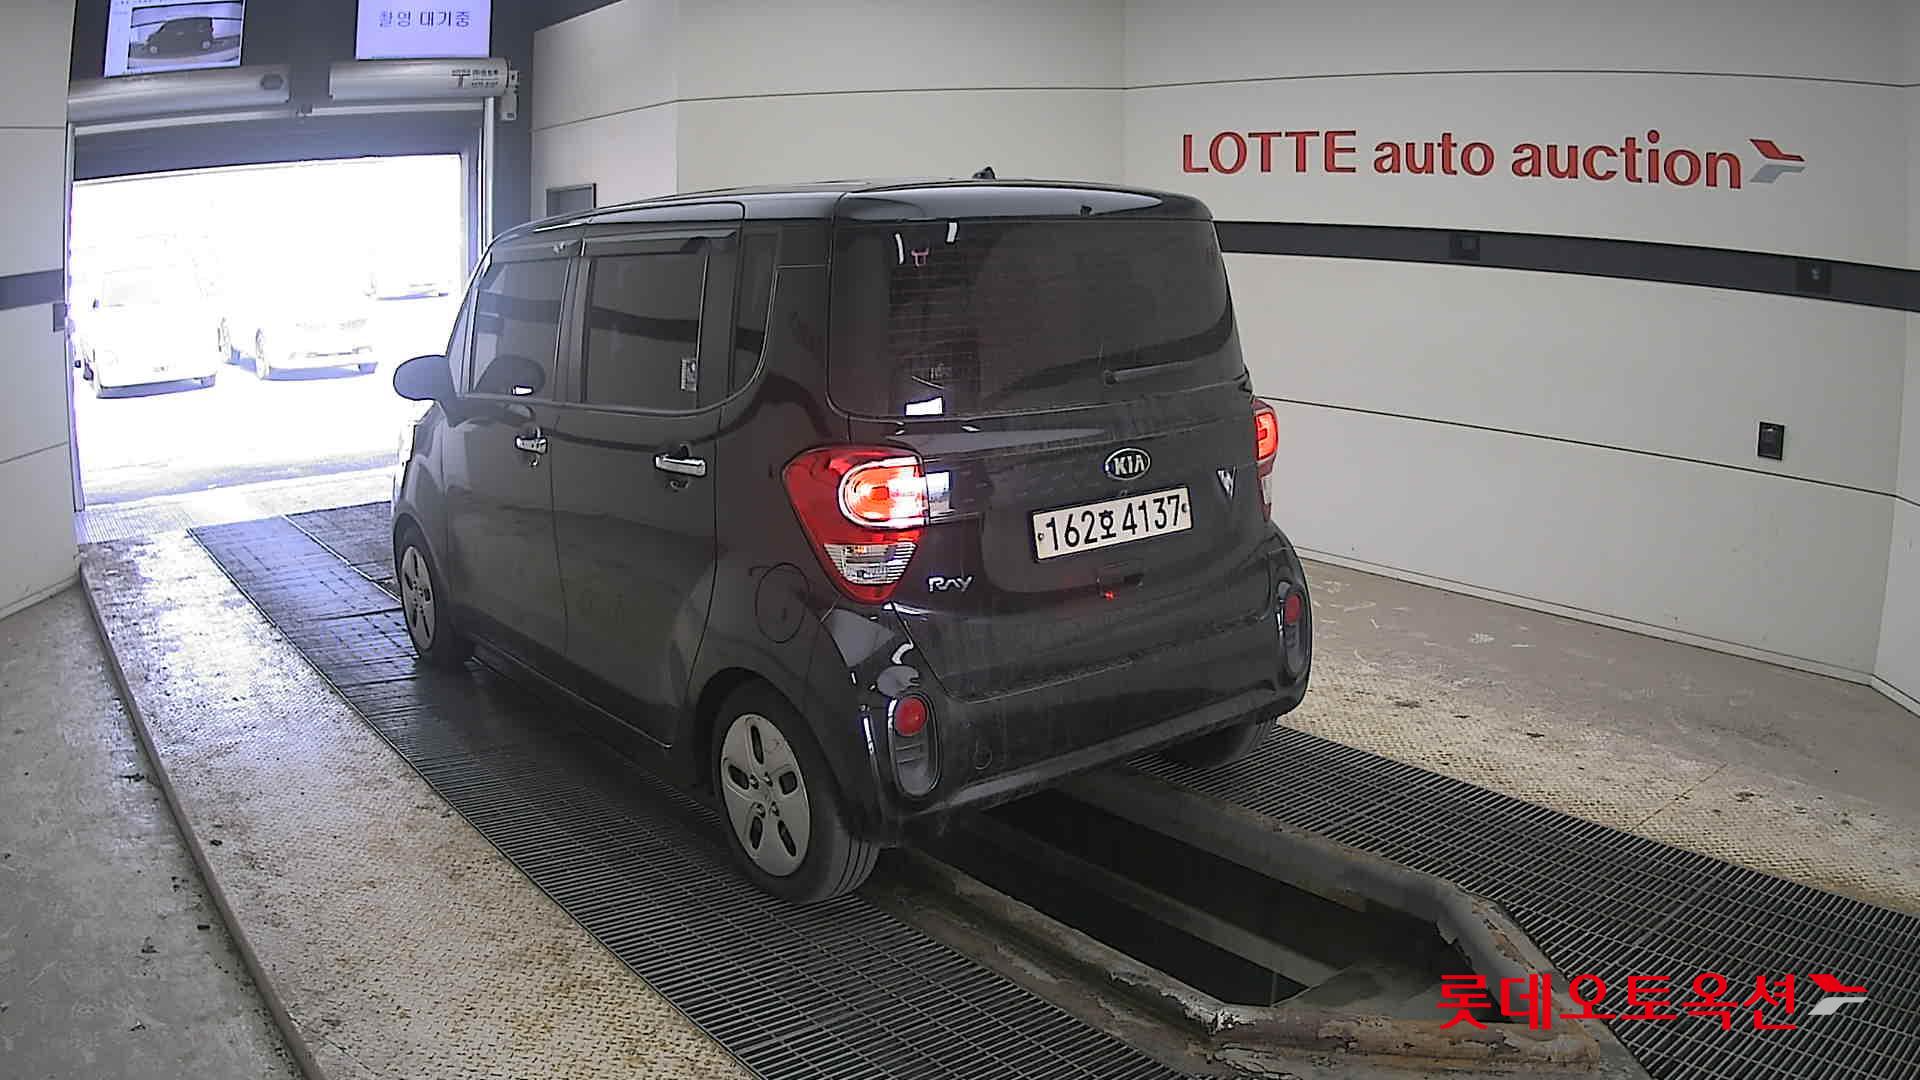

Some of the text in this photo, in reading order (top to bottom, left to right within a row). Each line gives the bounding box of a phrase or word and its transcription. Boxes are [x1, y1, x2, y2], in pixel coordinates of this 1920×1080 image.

[419, 10, 470, 28] 대기중
[1182, 129, 1743, 189] LOTTE auto auction
[1113, 454, 1145, 476] KIA
